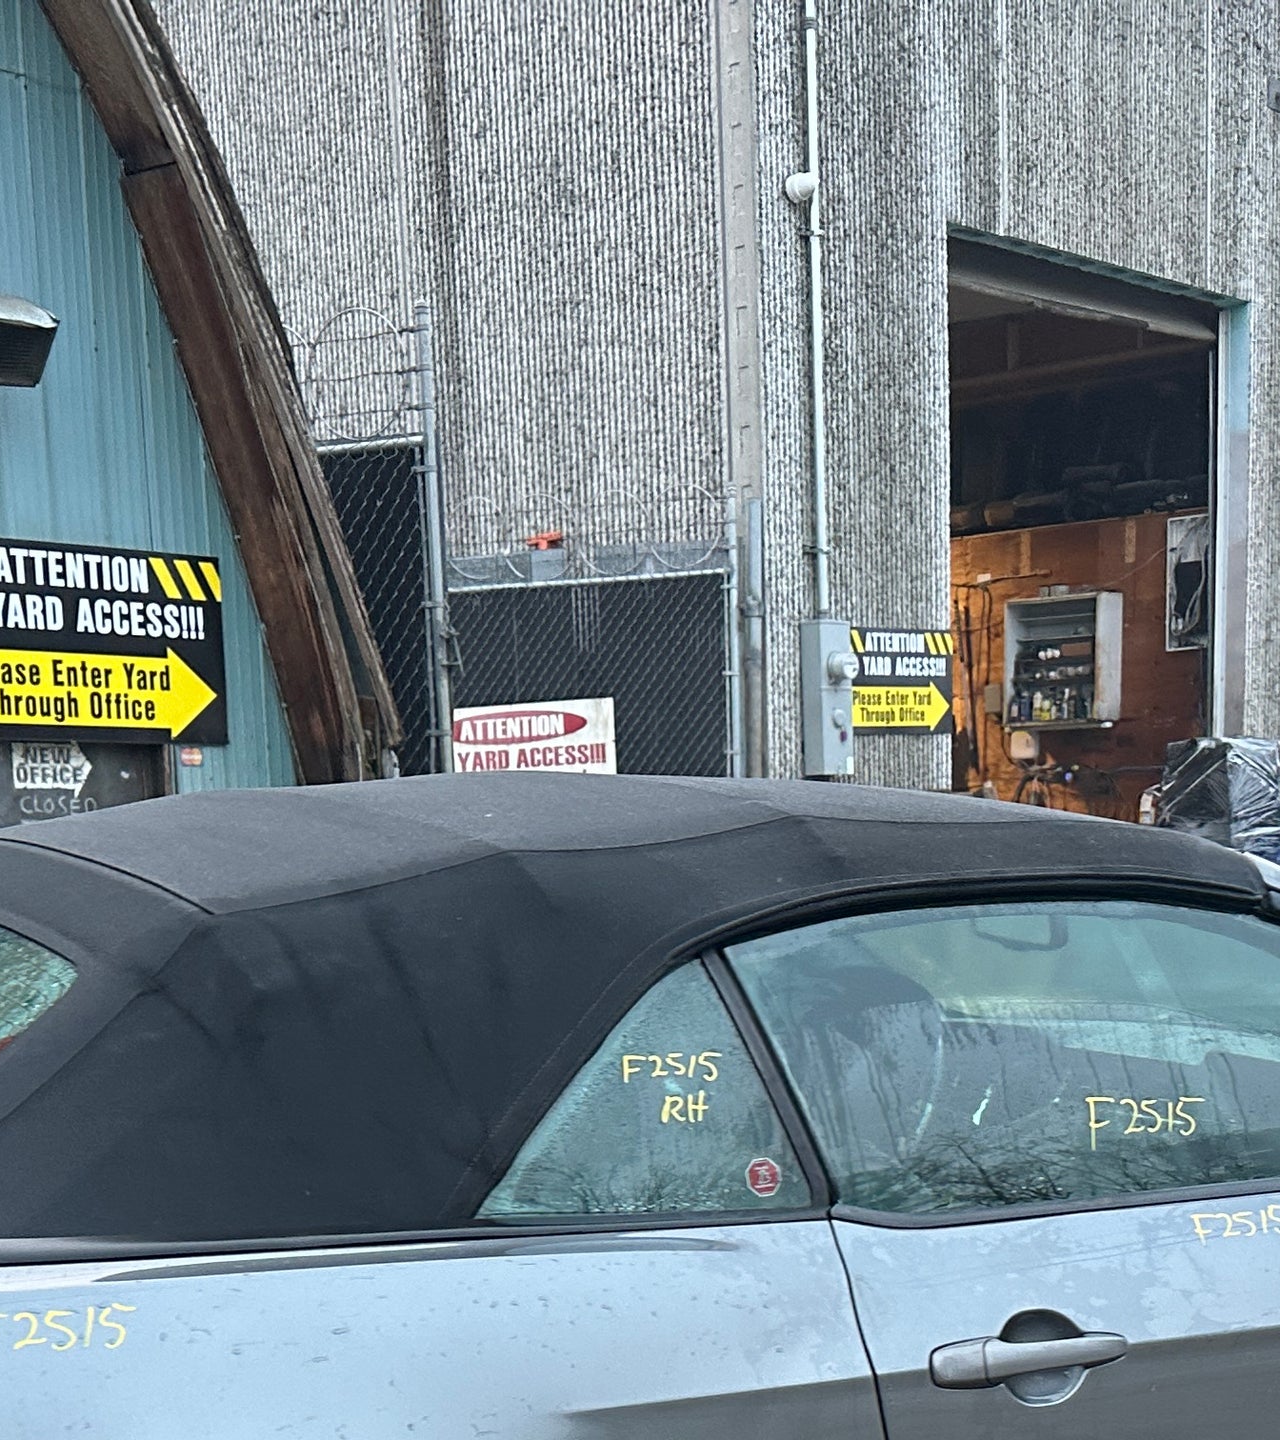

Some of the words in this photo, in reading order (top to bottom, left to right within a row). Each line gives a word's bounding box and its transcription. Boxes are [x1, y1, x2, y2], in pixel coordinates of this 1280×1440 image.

[76, 599, 206, 640] ACCESS!!!
[865, 632, 925, 653] ATTENTION
[52, 659, 113, 690] Enter
[123, 662, 171, 691] Yard
[863, 657, 892, 676] YARD
[895, 657, 946, 676] ACCESS!!!
[90, 692, 156, 721] Office
[853, 690, 882, 706] Please
[885, 691, 909, 706] Enter
[912, 691, 932, 706] Yard
[460, 714, 565, 741] ATTENTION
[859, 708, 896, 724] Through
[899, 707, 925, 722] Office
[25, 746, 70, 764] NEW
[458, 750, 510, 771] YARD
[516, 743, 607, 769] ACCESS!!!
[16, 765, 85, 784] OFFICE
[622, 1052, 723, 1083] F2515
[660, 1089, 709, 1124] RH
[1085, 1096, 1205, 1151] F2515
